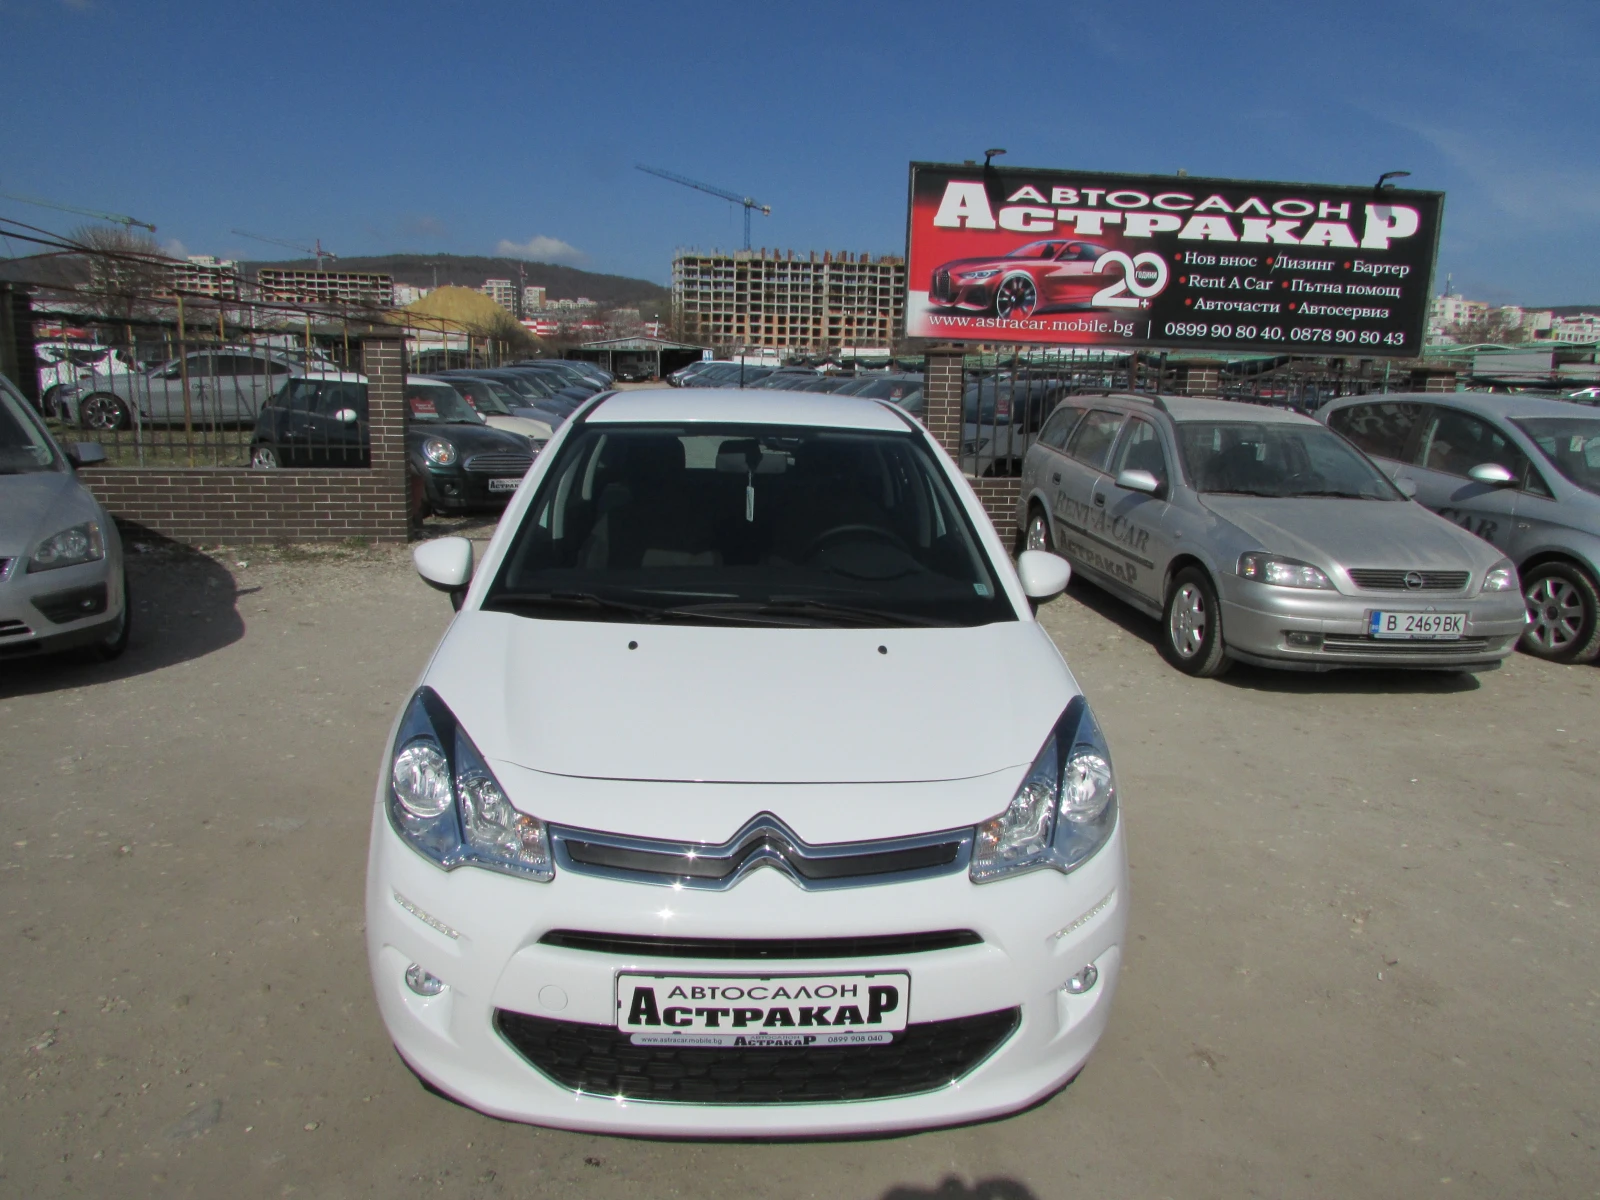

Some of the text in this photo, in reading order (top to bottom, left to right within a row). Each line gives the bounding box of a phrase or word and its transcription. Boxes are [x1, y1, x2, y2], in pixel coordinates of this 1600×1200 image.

[1007, 185, 1350, 220] АВТОСАЛОН
[1184, 252, 1258, 268] Нов внос
[1274, 256, 1336, 271] Лизинг
[1352, 260, 1410, 277] Бартер
[1188, 274, 1274, 291] Rent A Car
[1290, 279, 1401, 299] Пътна помощ
[1193, 298, 1281, 314] Авточасти
[1297, 301, 1390, 319] Автосервиз
[928, 314, 1135, 337] www.astracar.mobile.bg
[1164, 322, 1405, 346] 0899 90 80 40, 0878 90 80 43
[1386, 614, 1398, 631] B
[667, 983, 858, 1000] АВТОСАЛОН
[640, 1036, 723, 1045] www.astracar.mobile.bg
[867, 1034, 883, 1042] 040
